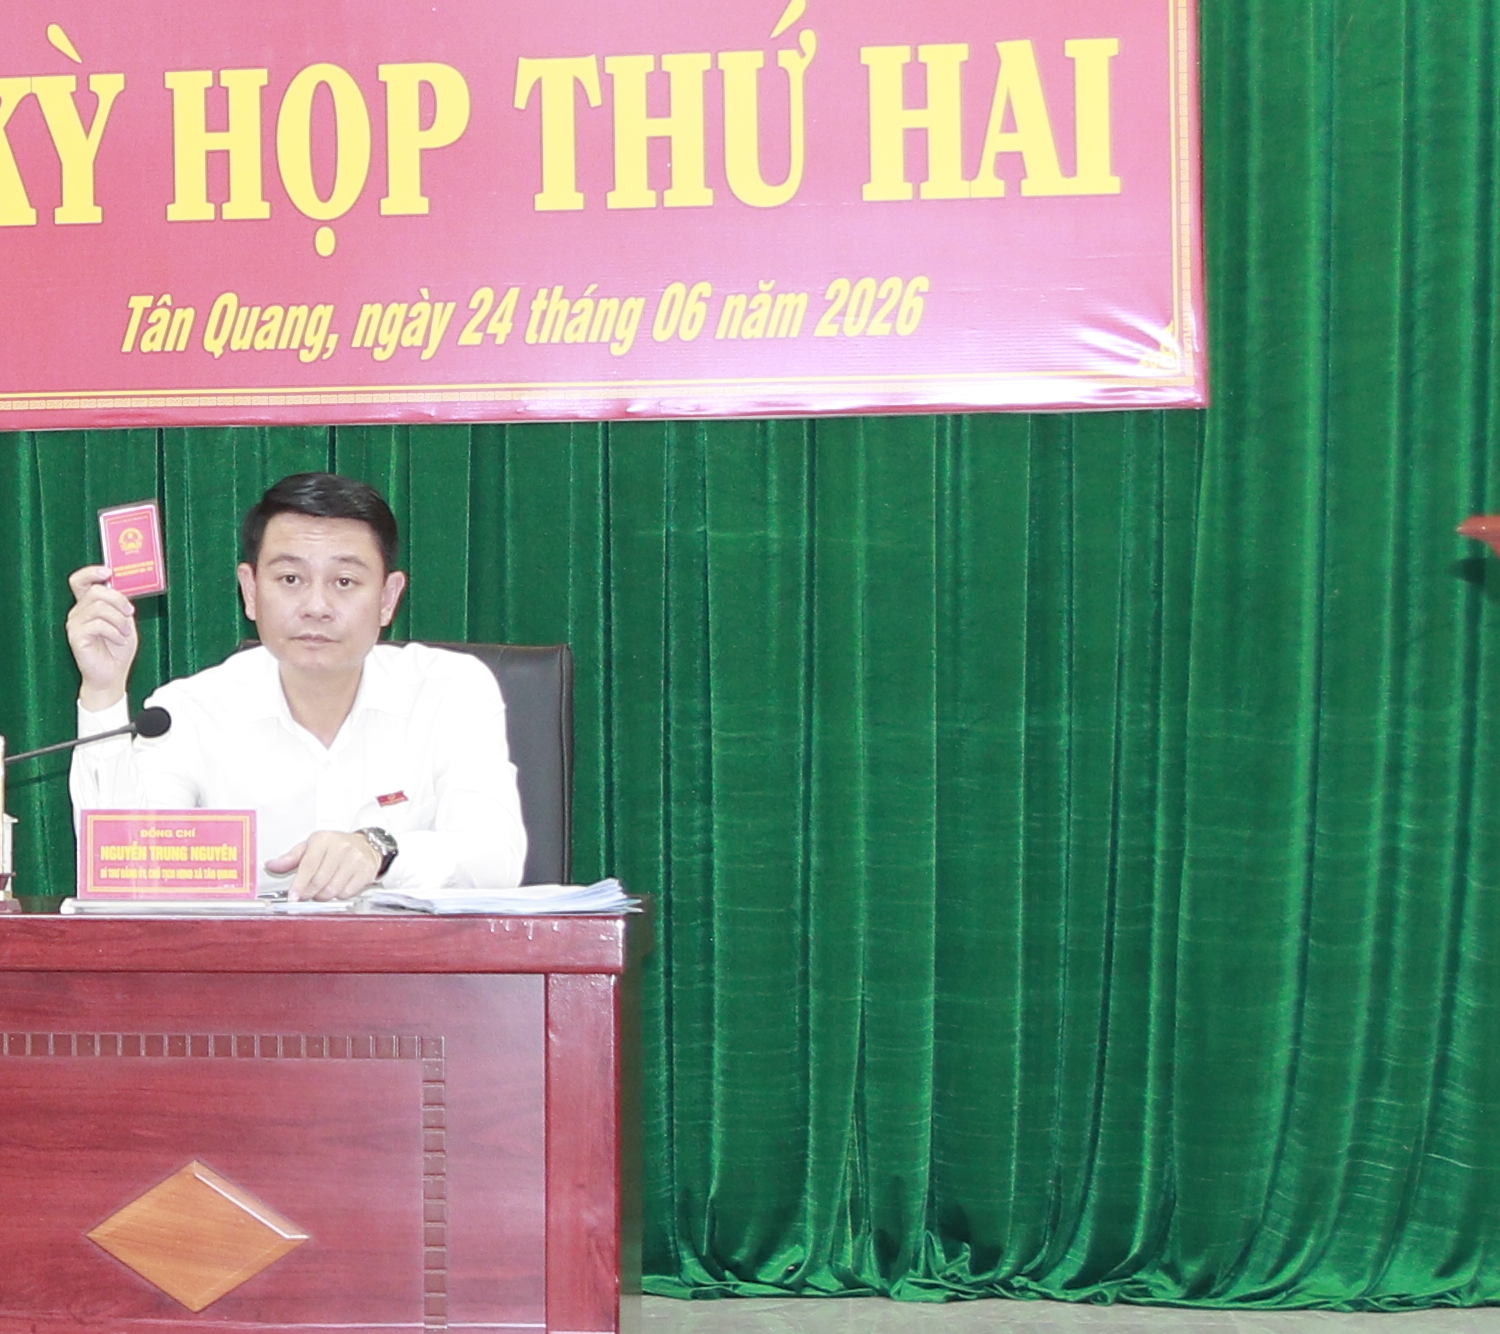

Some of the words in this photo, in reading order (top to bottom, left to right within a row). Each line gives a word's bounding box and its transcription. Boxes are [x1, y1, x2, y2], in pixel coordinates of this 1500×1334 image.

[166, 63, 471, 256] HỌP
[861, 38, 1121, 200] HAI
[123, 295, 195, 352] Tân
[204, 293, 339, 362] Quang,
[352, 289, 456, 360] ngày
[460, 288, 520, 344] 24
[526, 285, 645, 355] tháng
[654, 282, 712, 340] 06
[718, 283, 808, 338] năm
[817, 277, 929, 336] 2026
[100, 840, 147, 861] NGUYỄN
[150, 845, 188, 861] TRUNG
[191, 843, 237, 861] NGUYÊN
[140, 827, 173, 838] ĐỒNG
[175, 828, 196, 838] CHÍ
